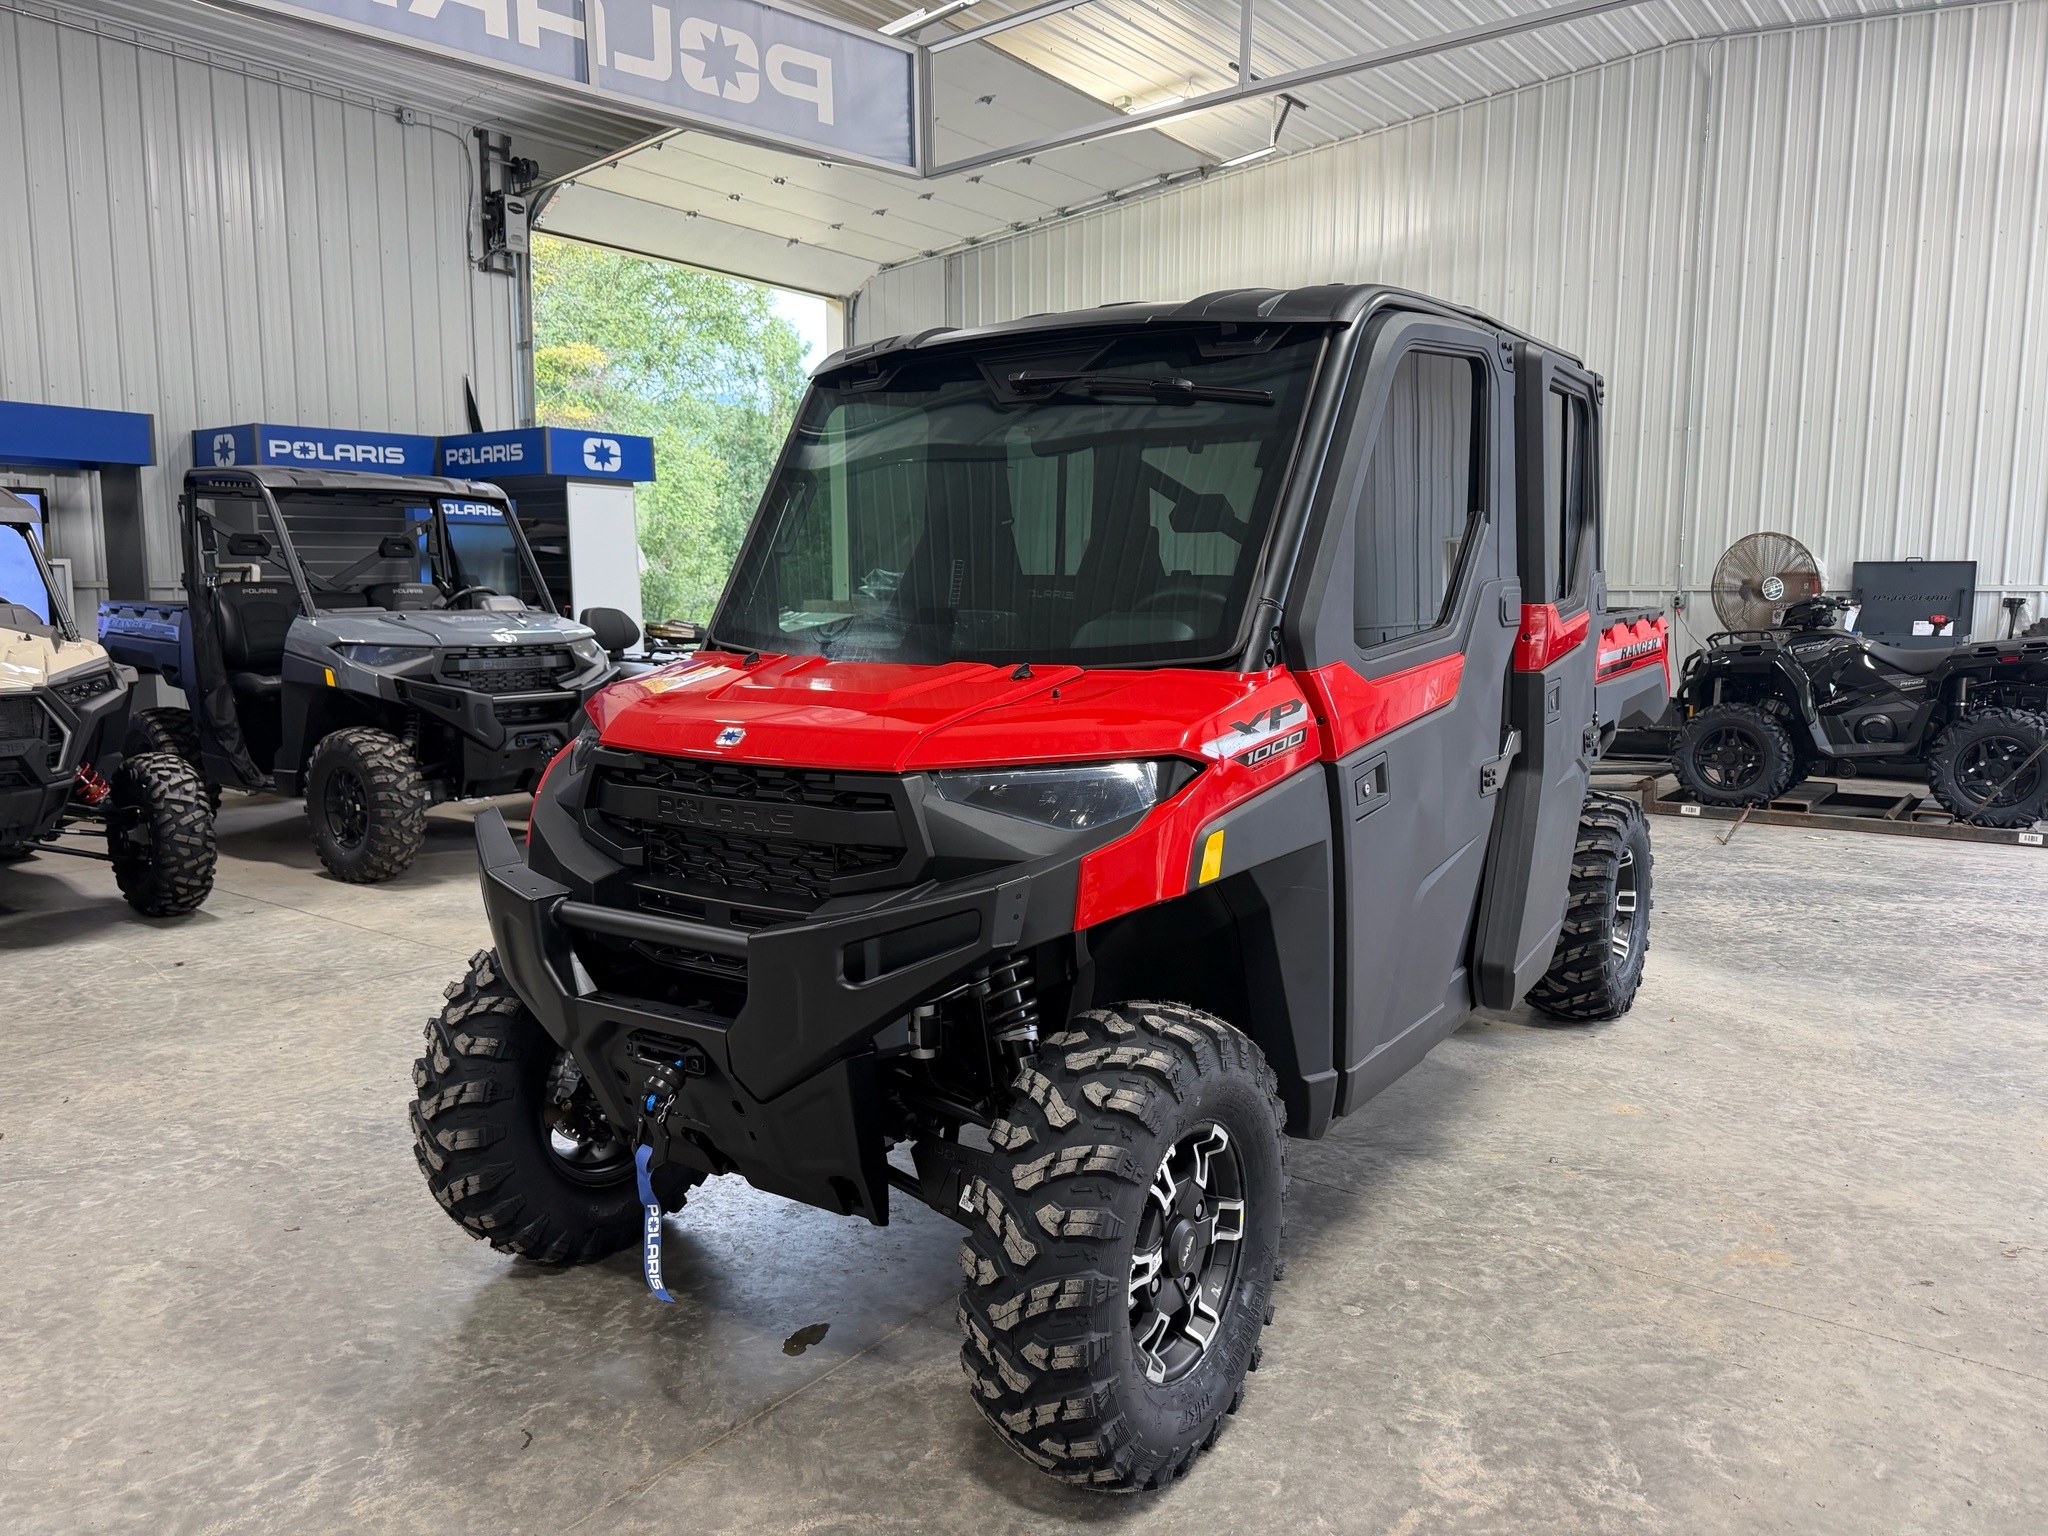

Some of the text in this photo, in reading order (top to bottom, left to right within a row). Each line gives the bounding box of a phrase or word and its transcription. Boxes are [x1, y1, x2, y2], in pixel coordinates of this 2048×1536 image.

[269, 439, 406, 465] POLARIS
[445, 442, 524, 466] POLARIS
[430, 503, 503, 516] OLARIS
[242, 587, 278, 595] POLARIS
[1026, 588, 1074, 600] OLARIS
[1620, 637, 1658, 660] RANGER
[482, 657, 543, 670] POLARIS
[1229, 699, 1303, 734] XP
[1247, 730, 1304, 766] 1000
[656, 795, 795, 835] POLARIS
[645, 1203, 664, 1290] POLARIS
